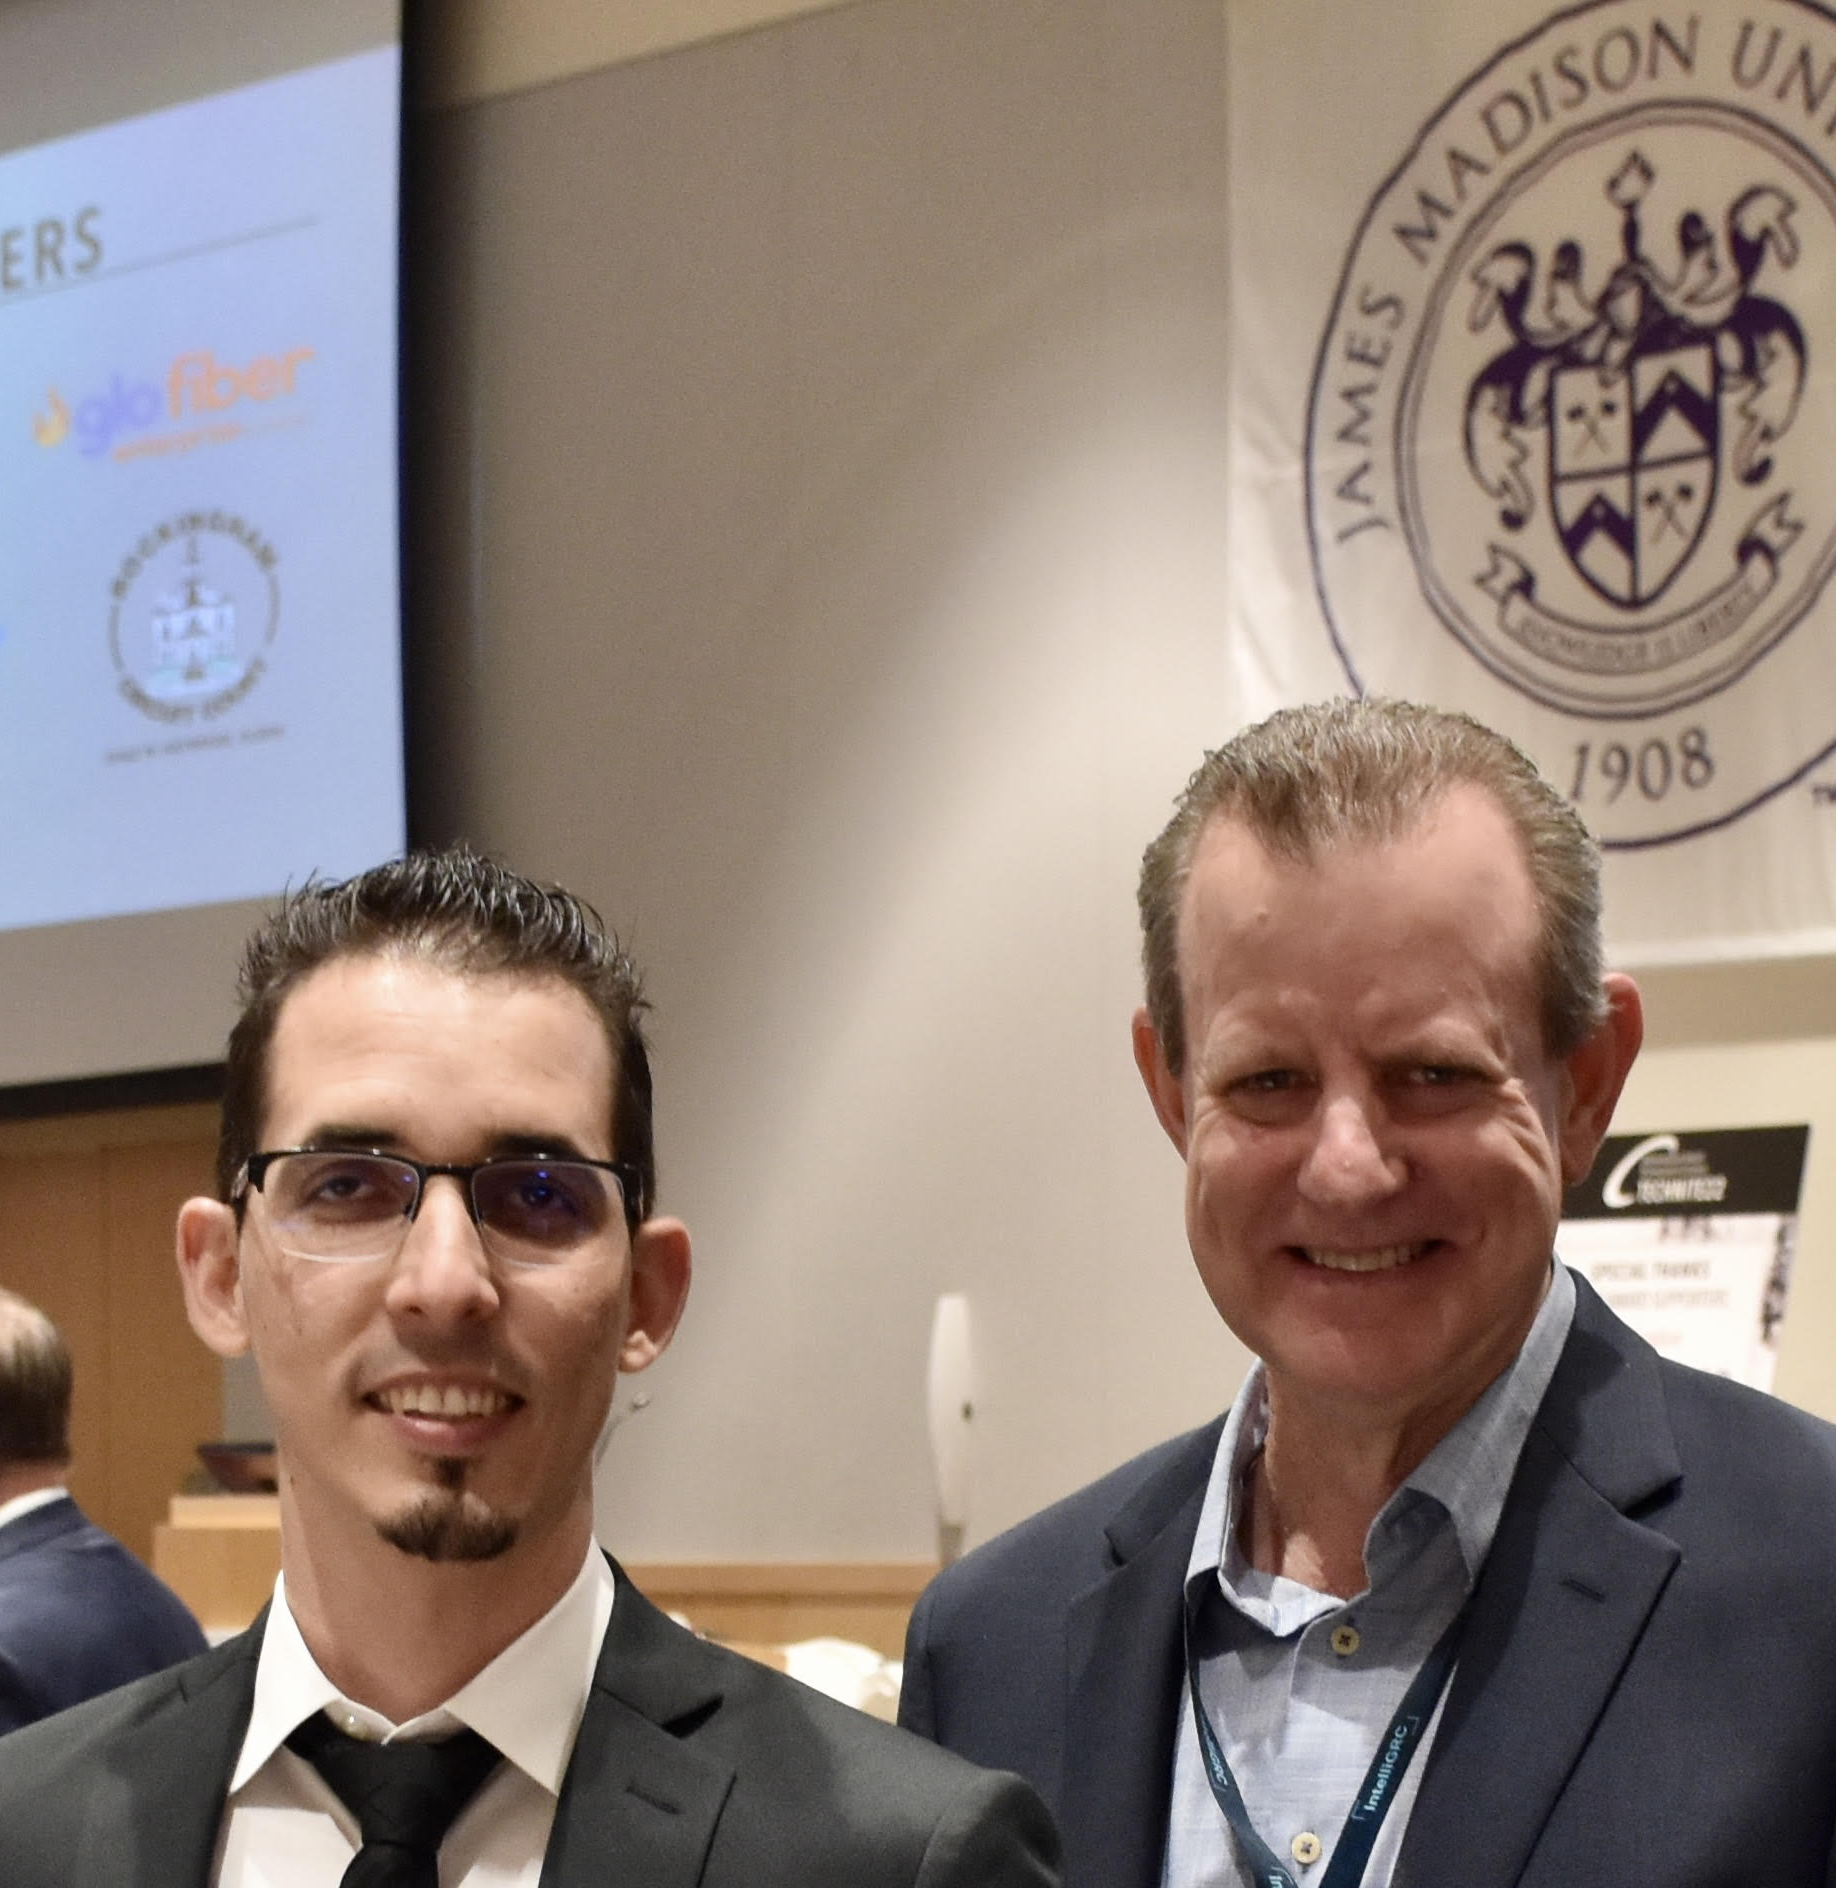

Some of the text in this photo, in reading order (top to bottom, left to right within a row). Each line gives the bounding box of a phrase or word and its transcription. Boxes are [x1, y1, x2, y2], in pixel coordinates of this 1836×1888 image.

[1335, 284, 1404, 546] JAMES
[1393, 16, 1700, 267] MADISON
[1570, 726, 1715, 801] 1908
[1363, 1725, 1408, 1811] IntelliGRC
